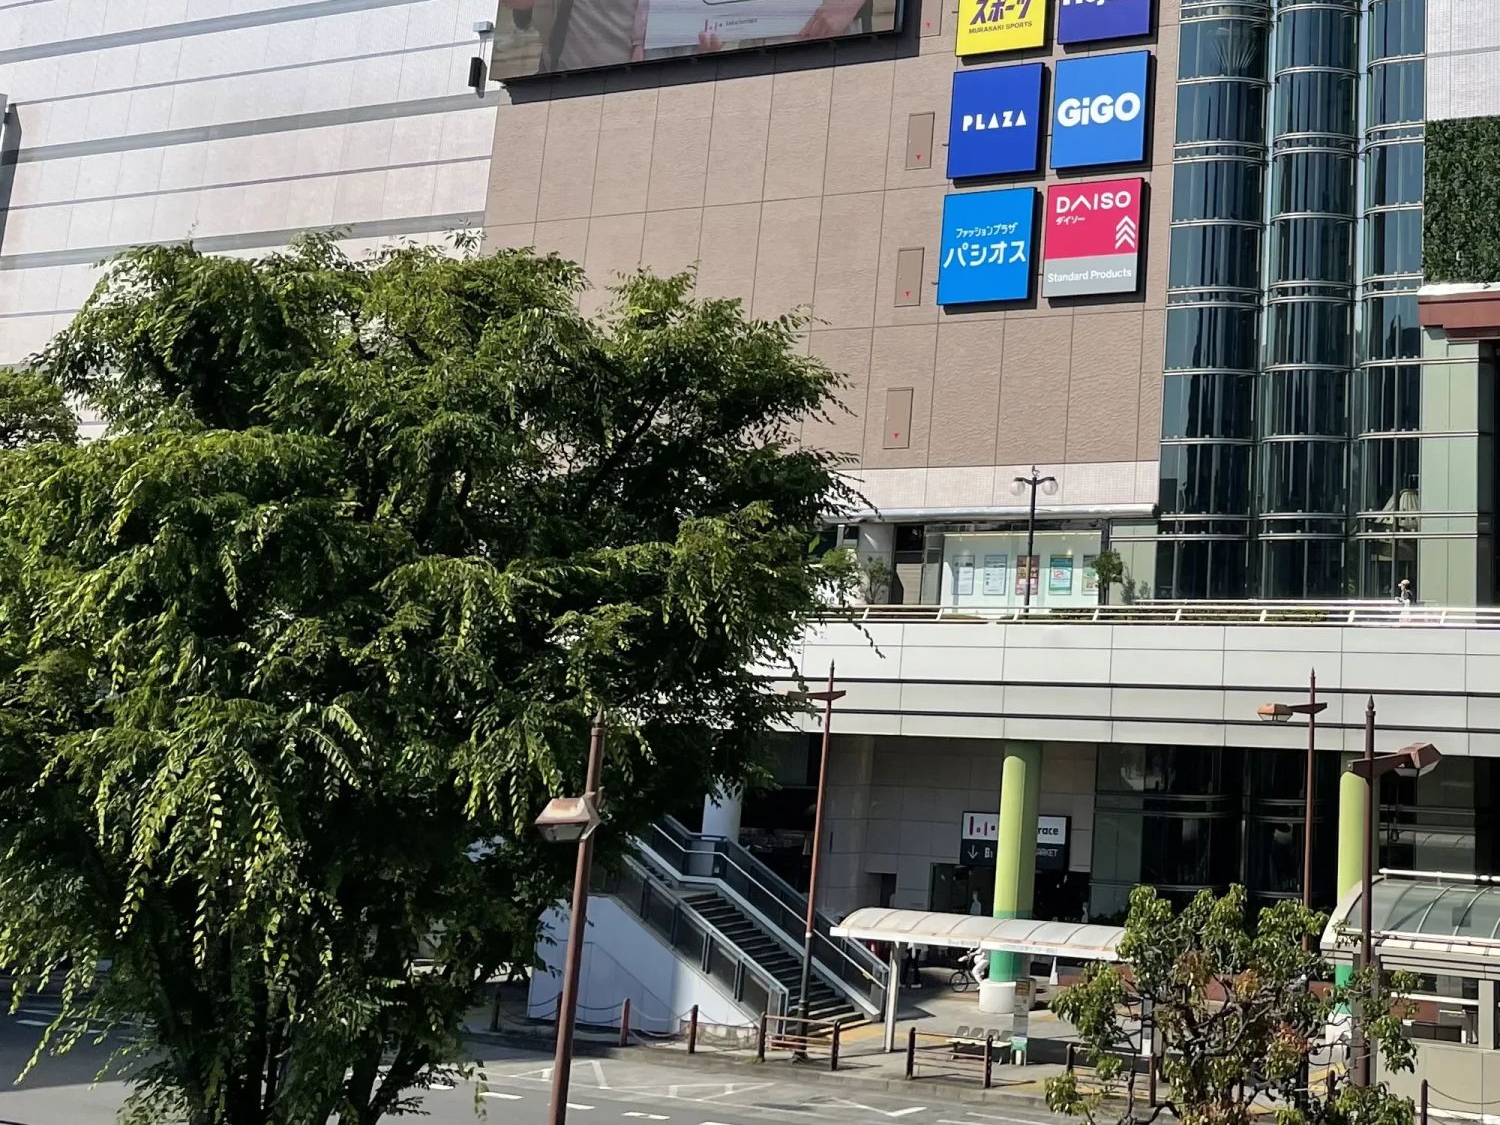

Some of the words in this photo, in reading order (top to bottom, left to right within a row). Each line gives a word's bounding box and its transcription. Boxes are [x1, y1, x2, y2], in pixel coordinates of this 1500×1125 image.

[968, 24, 1004, 35] MURASAKI
[1005, 21, 1033, 30] SPORTS
[1056, 91, 1141, 127] GiGO
[962, 109, 1027, 132] PLAZA
[1055, 190, 1131, 214] DAISO
[956, 222, 1018, 238] ファッションプラザ
[1055, 215, 1086, 226] ダイソー
[943, 240, 1027, 269] パシオス
[1048, 271, 1089, 283] Standard
[1090, 268, 1132, 281] Products
